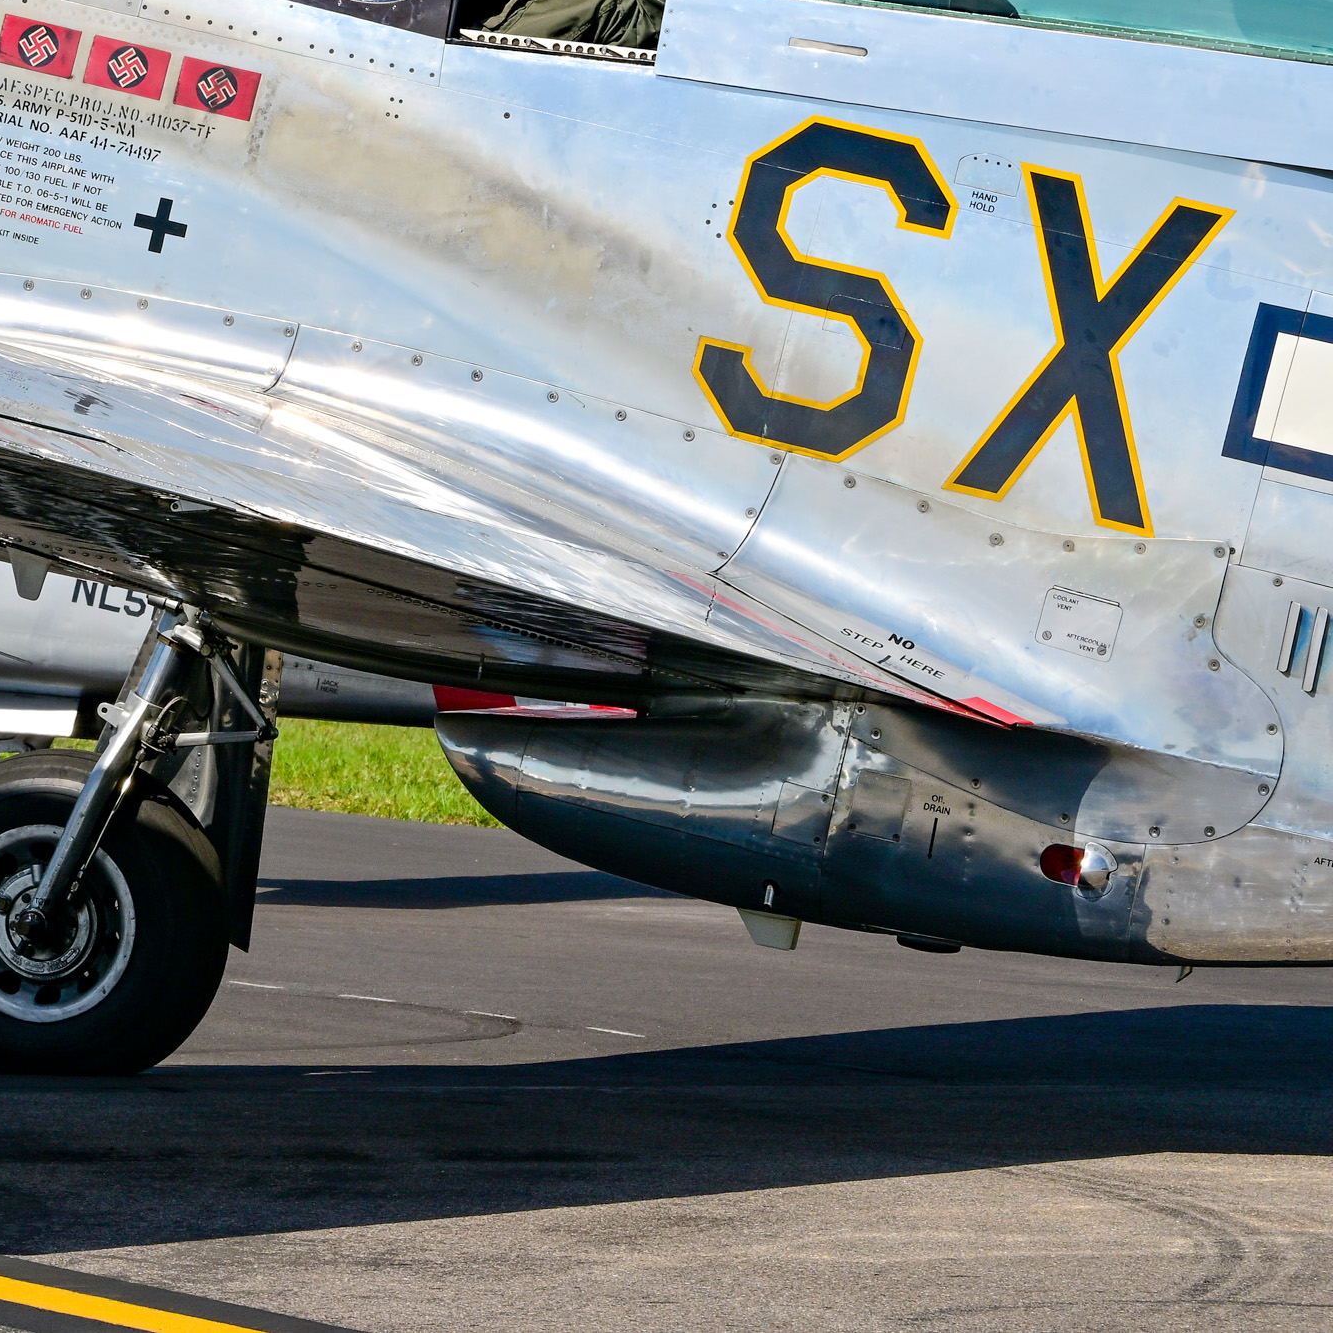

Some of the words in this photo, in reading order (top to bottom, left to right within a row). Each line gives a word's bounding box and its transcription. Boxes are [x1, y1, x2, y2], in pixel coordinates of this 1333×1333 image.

[12, 99, 52, 116] ARMY
[56, 108, 135, 138] P-51D-5-NA
[6, 137, 41, 153] WEIGHT
[43, 147, 61, 158] 200
[64, 152, 83, 164] LBS.
[29, 119, 53, 135] NO.
[59, 127, 88, 142] AAF
[90, 135, 162, 162] 44-74497
[17, 154, 39, 166] THIS
[41, 160, 88, 178] AIRPLANE
[91, 172, 115, 184] WITH
[4, 165, 41, 181] 100/130
[43, 175, 68, 189] FUEL.
[72, 181, 82, 191] IF
[83, 184, 103, 196] NOT
[16, 184, 33, 195] T.O.
[36, 189, 69, 203] 06-5-1
[71, 197, 92, 209] WILL
[95, 202, 109, 213] BE
[969, 200, 995, 213] HOLD
[971, 190, 998, 203] HAND
[0, 208, 17, 220] FOR
[19, 213, 61, 229] AROMATIC
[63, 223, 83, 235] FUEL
[15, 197, 34, 209] FOR
[36, 202, 89, 222] EMERGENCY
[90, 216, 123, 230] ACTION
[12, 232, 40, 245] INSIDE
[691, 114, 1237, 538] SX
[71, 578, 158, 621] NL5
[1052, 593, 1080, 606] COOLANT
[1057, 602, 1073, 612] VENT
[887, 633, 916, 650] NO
[1078, 643, 1095, 653] VENT
[840, 627, 884, 649] STEP
[899, 654, 946, 680] HERE
[320, 685, 338, 694] HERE
[321, 679, 339, 688] JACK
[923, 802, 951, 815] DRAIN
[1313, 856, 1333, 868] AFT
